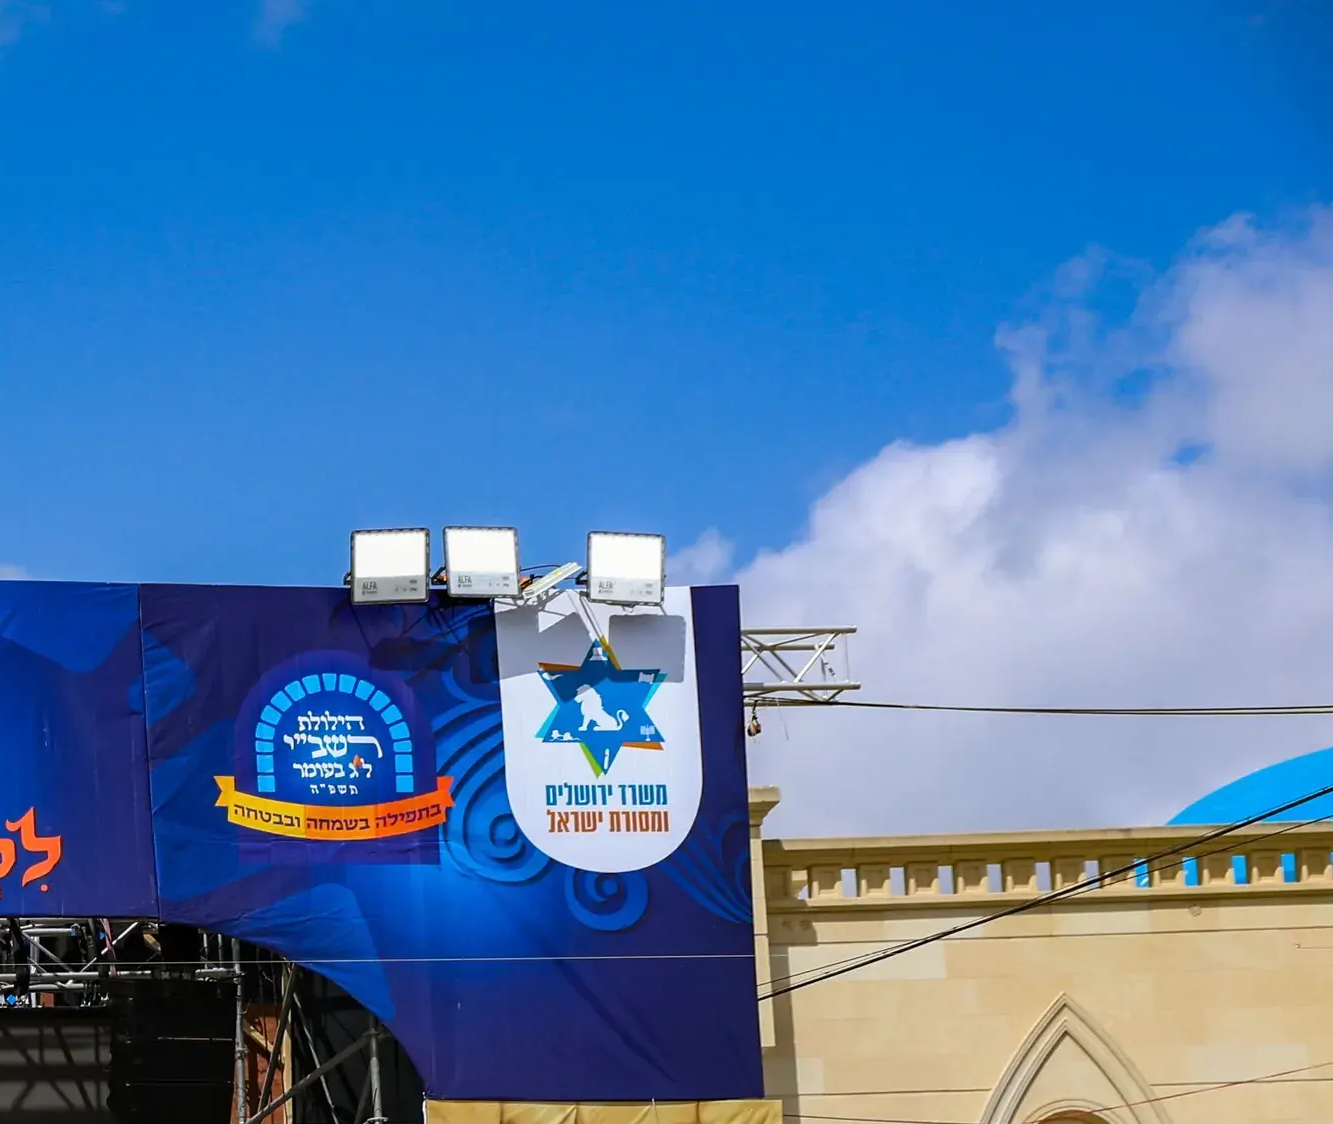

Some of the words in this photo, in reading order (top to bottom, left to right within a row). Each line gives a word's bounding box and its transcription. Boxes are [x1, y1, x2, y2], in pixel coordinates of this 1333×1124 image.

[297, 710, 366, 734] הילולת
[292, 762, 346, 780] בעומר
[545, 783, 614, 807] ירושלים
[619, 783, 667, 805] משרד
[233, 802, 301, 830] ובבטחה
[305, 814, 370, 833] בשמחה
[375, 801, 443, 830] בתפילה
[546, 808, 605, 834] ישראל
[609, 808, 669, 833] ומסורת
